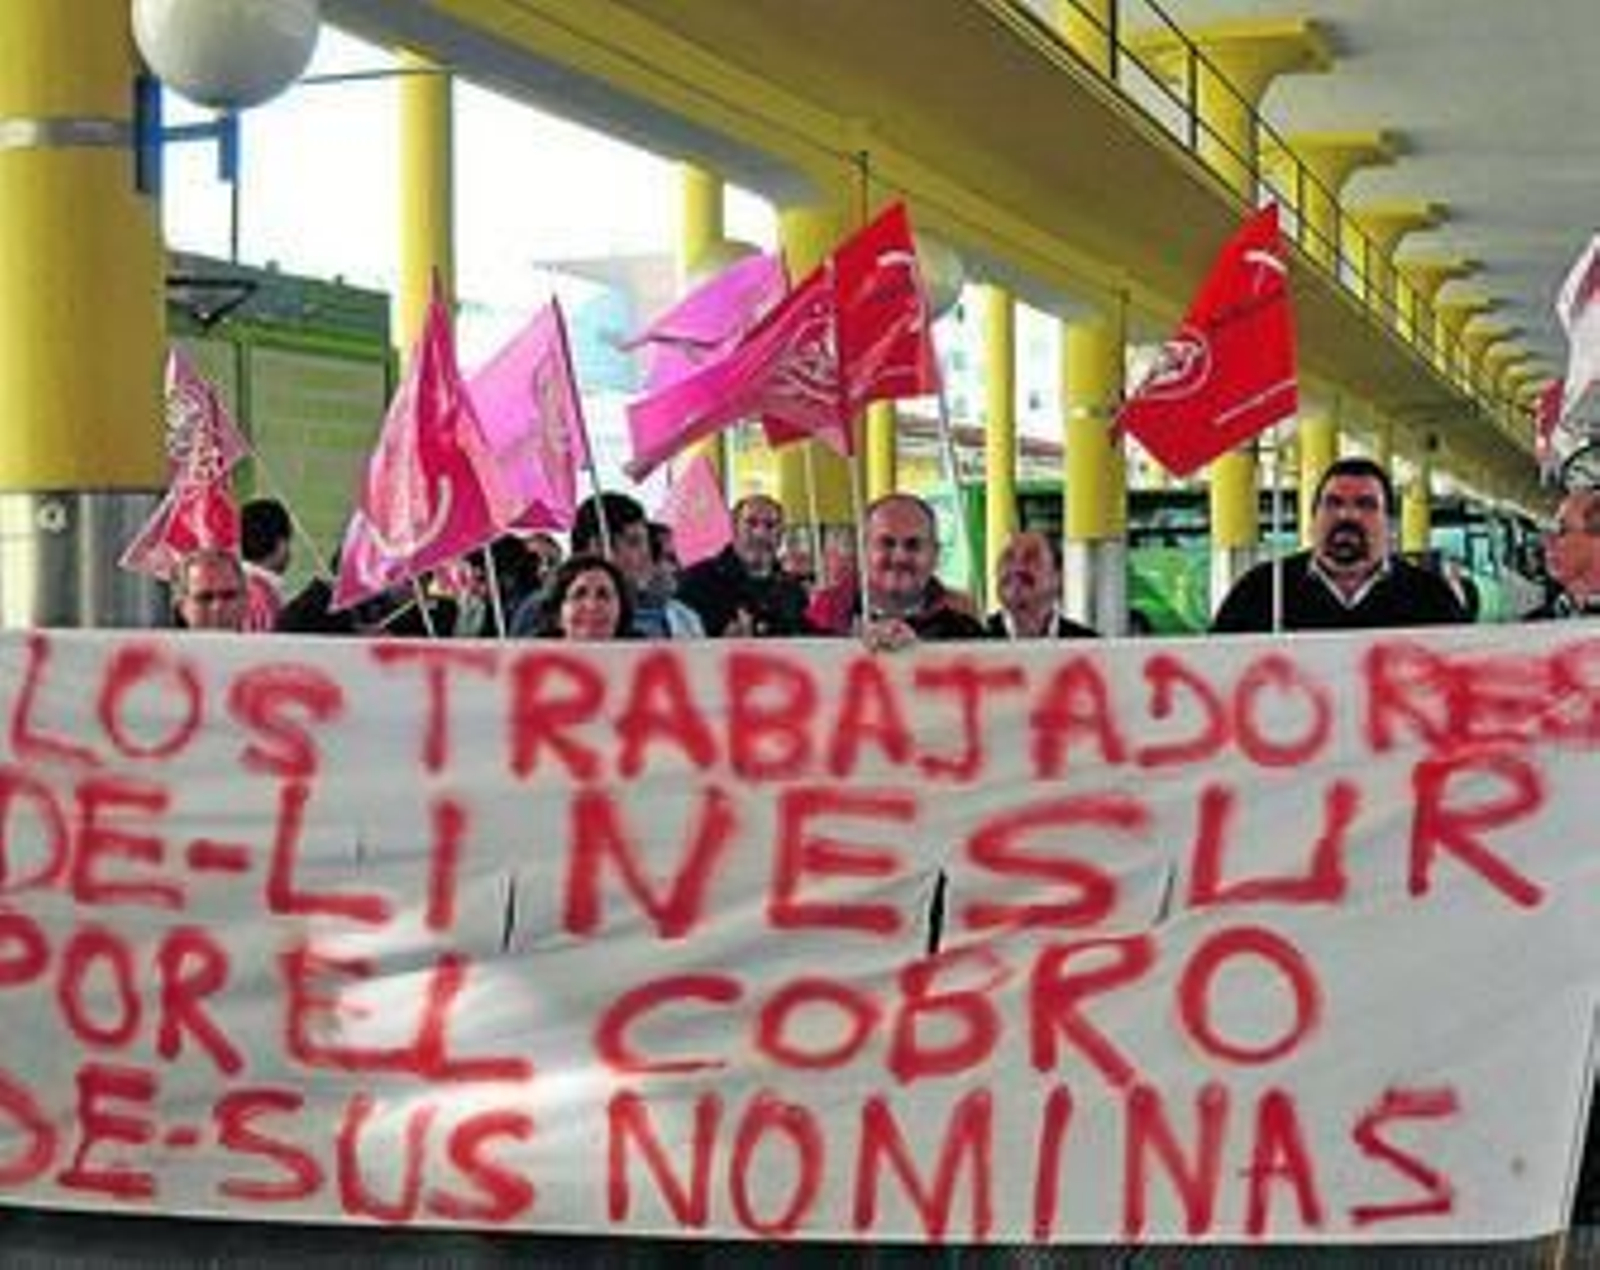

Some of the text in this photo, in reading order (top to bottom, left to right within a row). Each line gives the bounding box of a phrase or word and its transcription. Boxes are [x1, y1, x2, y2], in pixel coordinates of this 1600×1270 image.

[9, 633, 346, 777] LOS
[279, 943, 534, 1082] EL
[592, 920, 1321, 1088] COBRO
[606, 1080, 1460, 1243] NOMINAS
